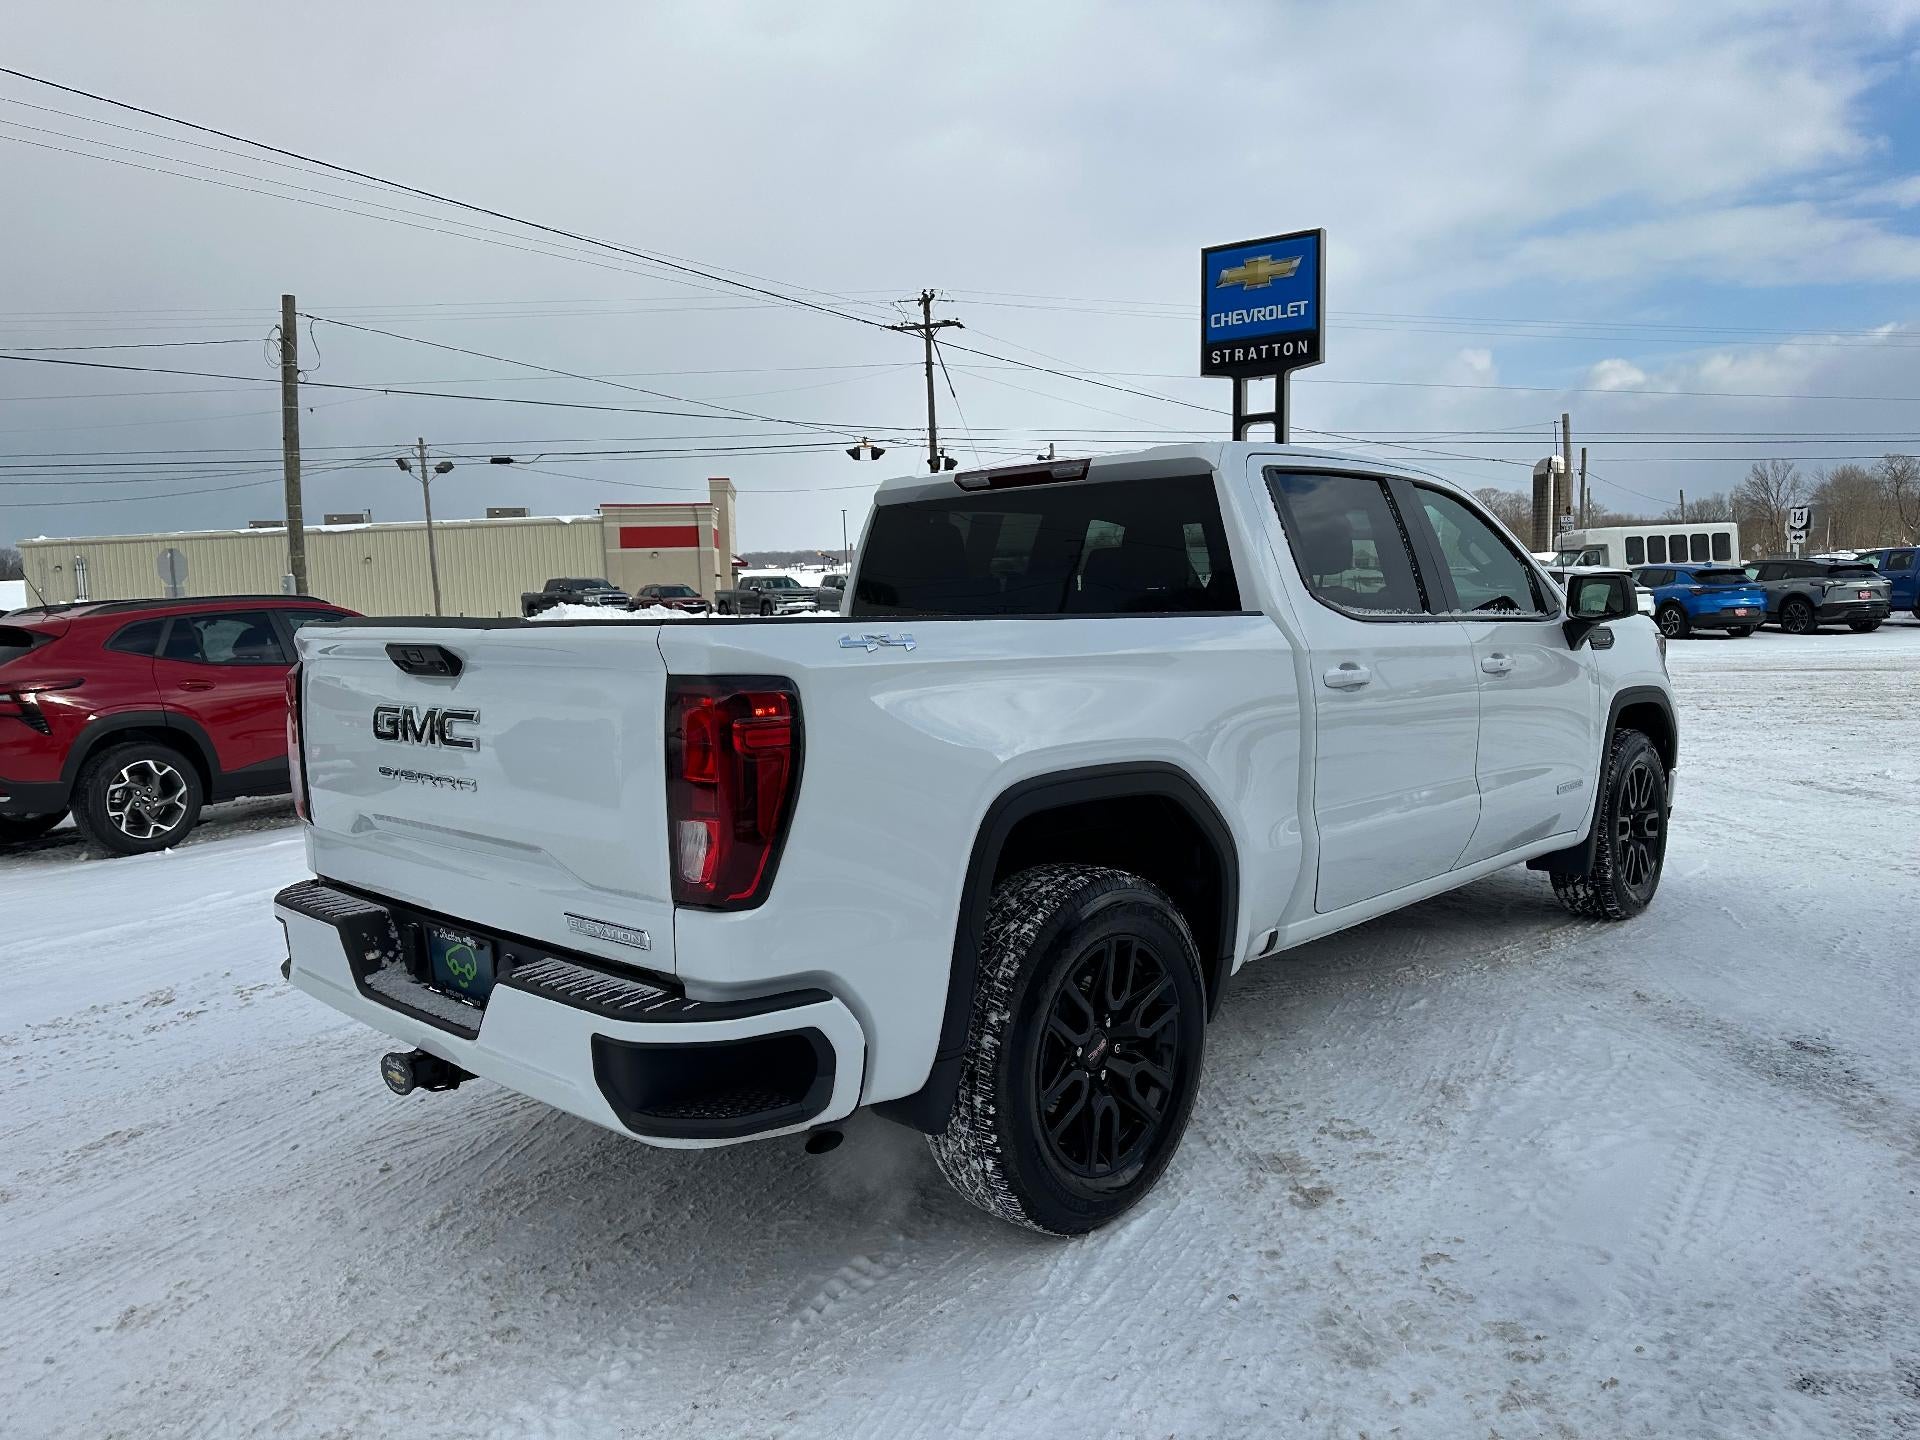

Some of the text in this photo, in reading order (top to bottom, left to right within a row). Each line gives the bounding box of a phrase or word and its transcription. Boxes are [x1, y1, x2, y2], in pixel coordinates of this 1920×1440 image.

[1210, 300, 1309, 328] CHEVROLET
[1211, 340, 1308, 364] STRATTON
[1793, 511, 1804, 524] 14
[373, 703, 480, 752] GMC
[378, 765, 478, 793] SIERRA
[568, 918, 642, 946] ELEVATION
